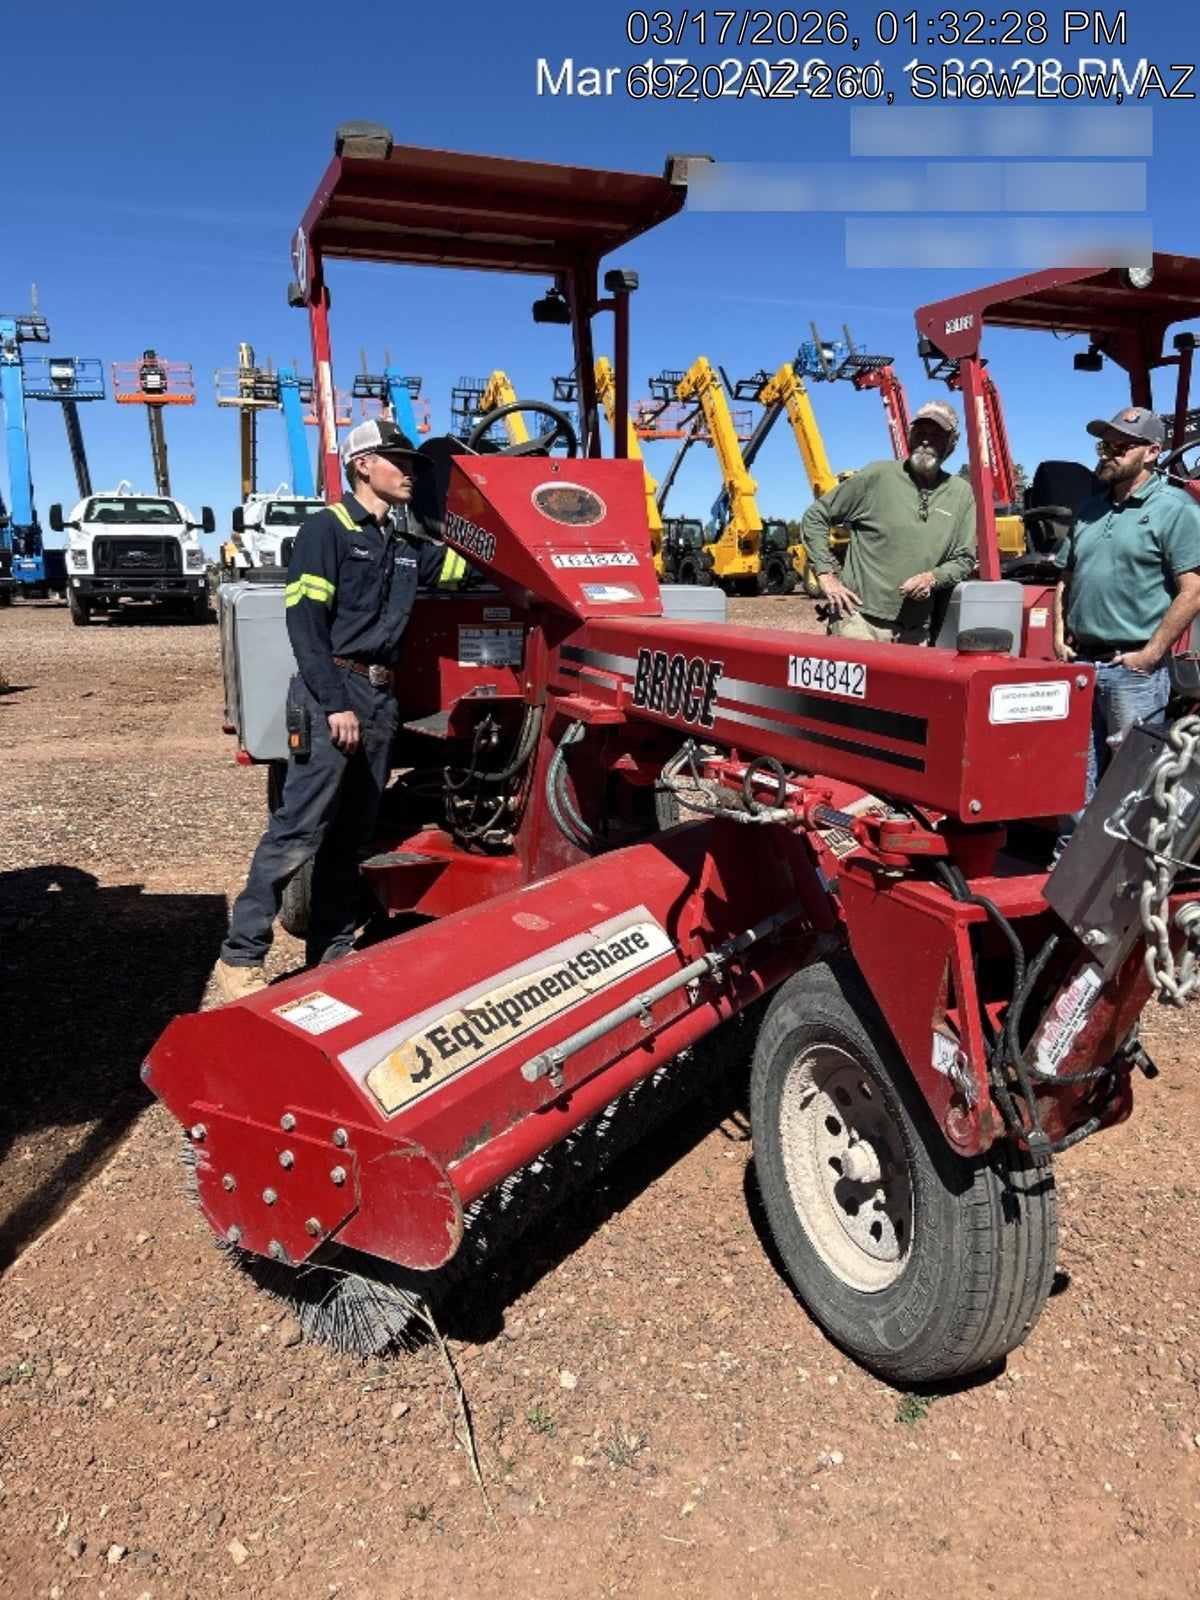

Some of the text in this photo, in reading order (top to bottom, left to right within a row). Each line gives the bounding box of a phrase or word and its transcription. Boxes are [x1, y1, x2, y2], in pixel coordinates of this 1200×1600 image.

[554, 553, 637, 566] 164842
[632, 647, 724, 729] BROCE
[790, 655, 865, 696] 164842
[424, 930, 650, 1060] EquipmentShare
